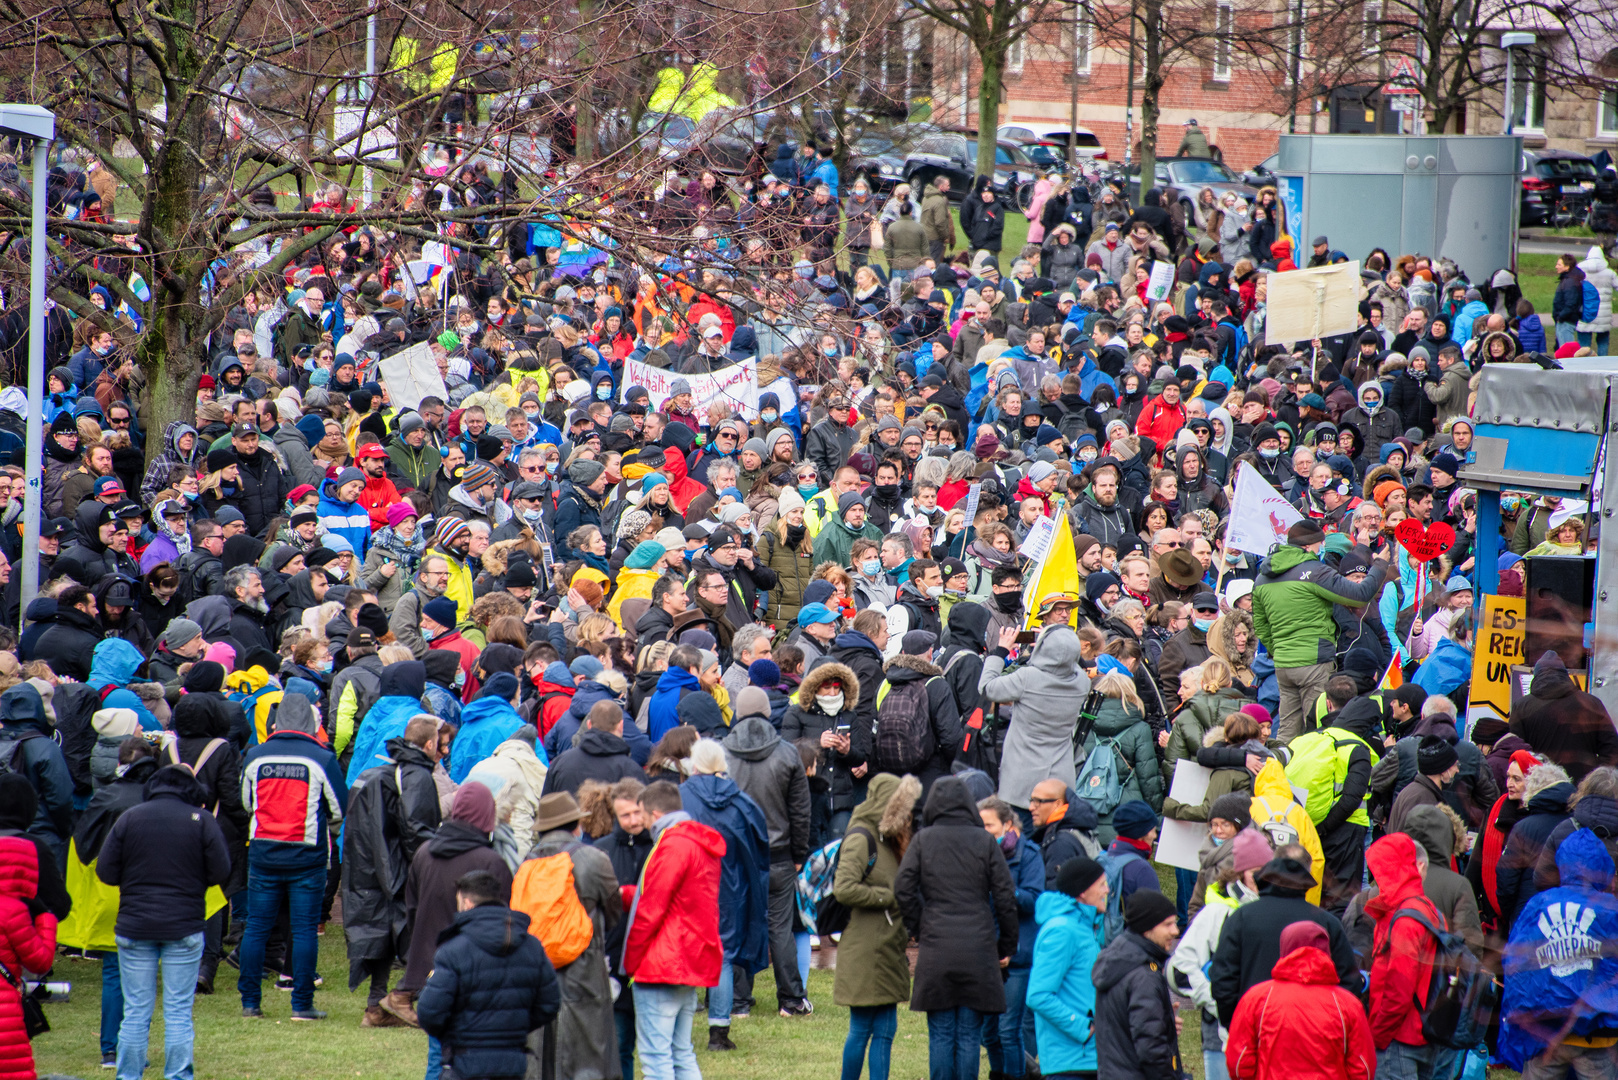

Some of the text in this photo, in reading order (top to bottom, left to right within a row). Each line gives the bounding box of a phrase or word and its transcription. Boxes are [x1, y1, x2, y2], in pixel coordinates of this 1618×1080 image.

[629, 362, 752, 397] Verhältnmäßigkeit
[1399, 524, 1450, 541] VERTRAUE
[1416, 546, 1434, 556] HERZ
[1492, 608, 1525, 630] ES-
